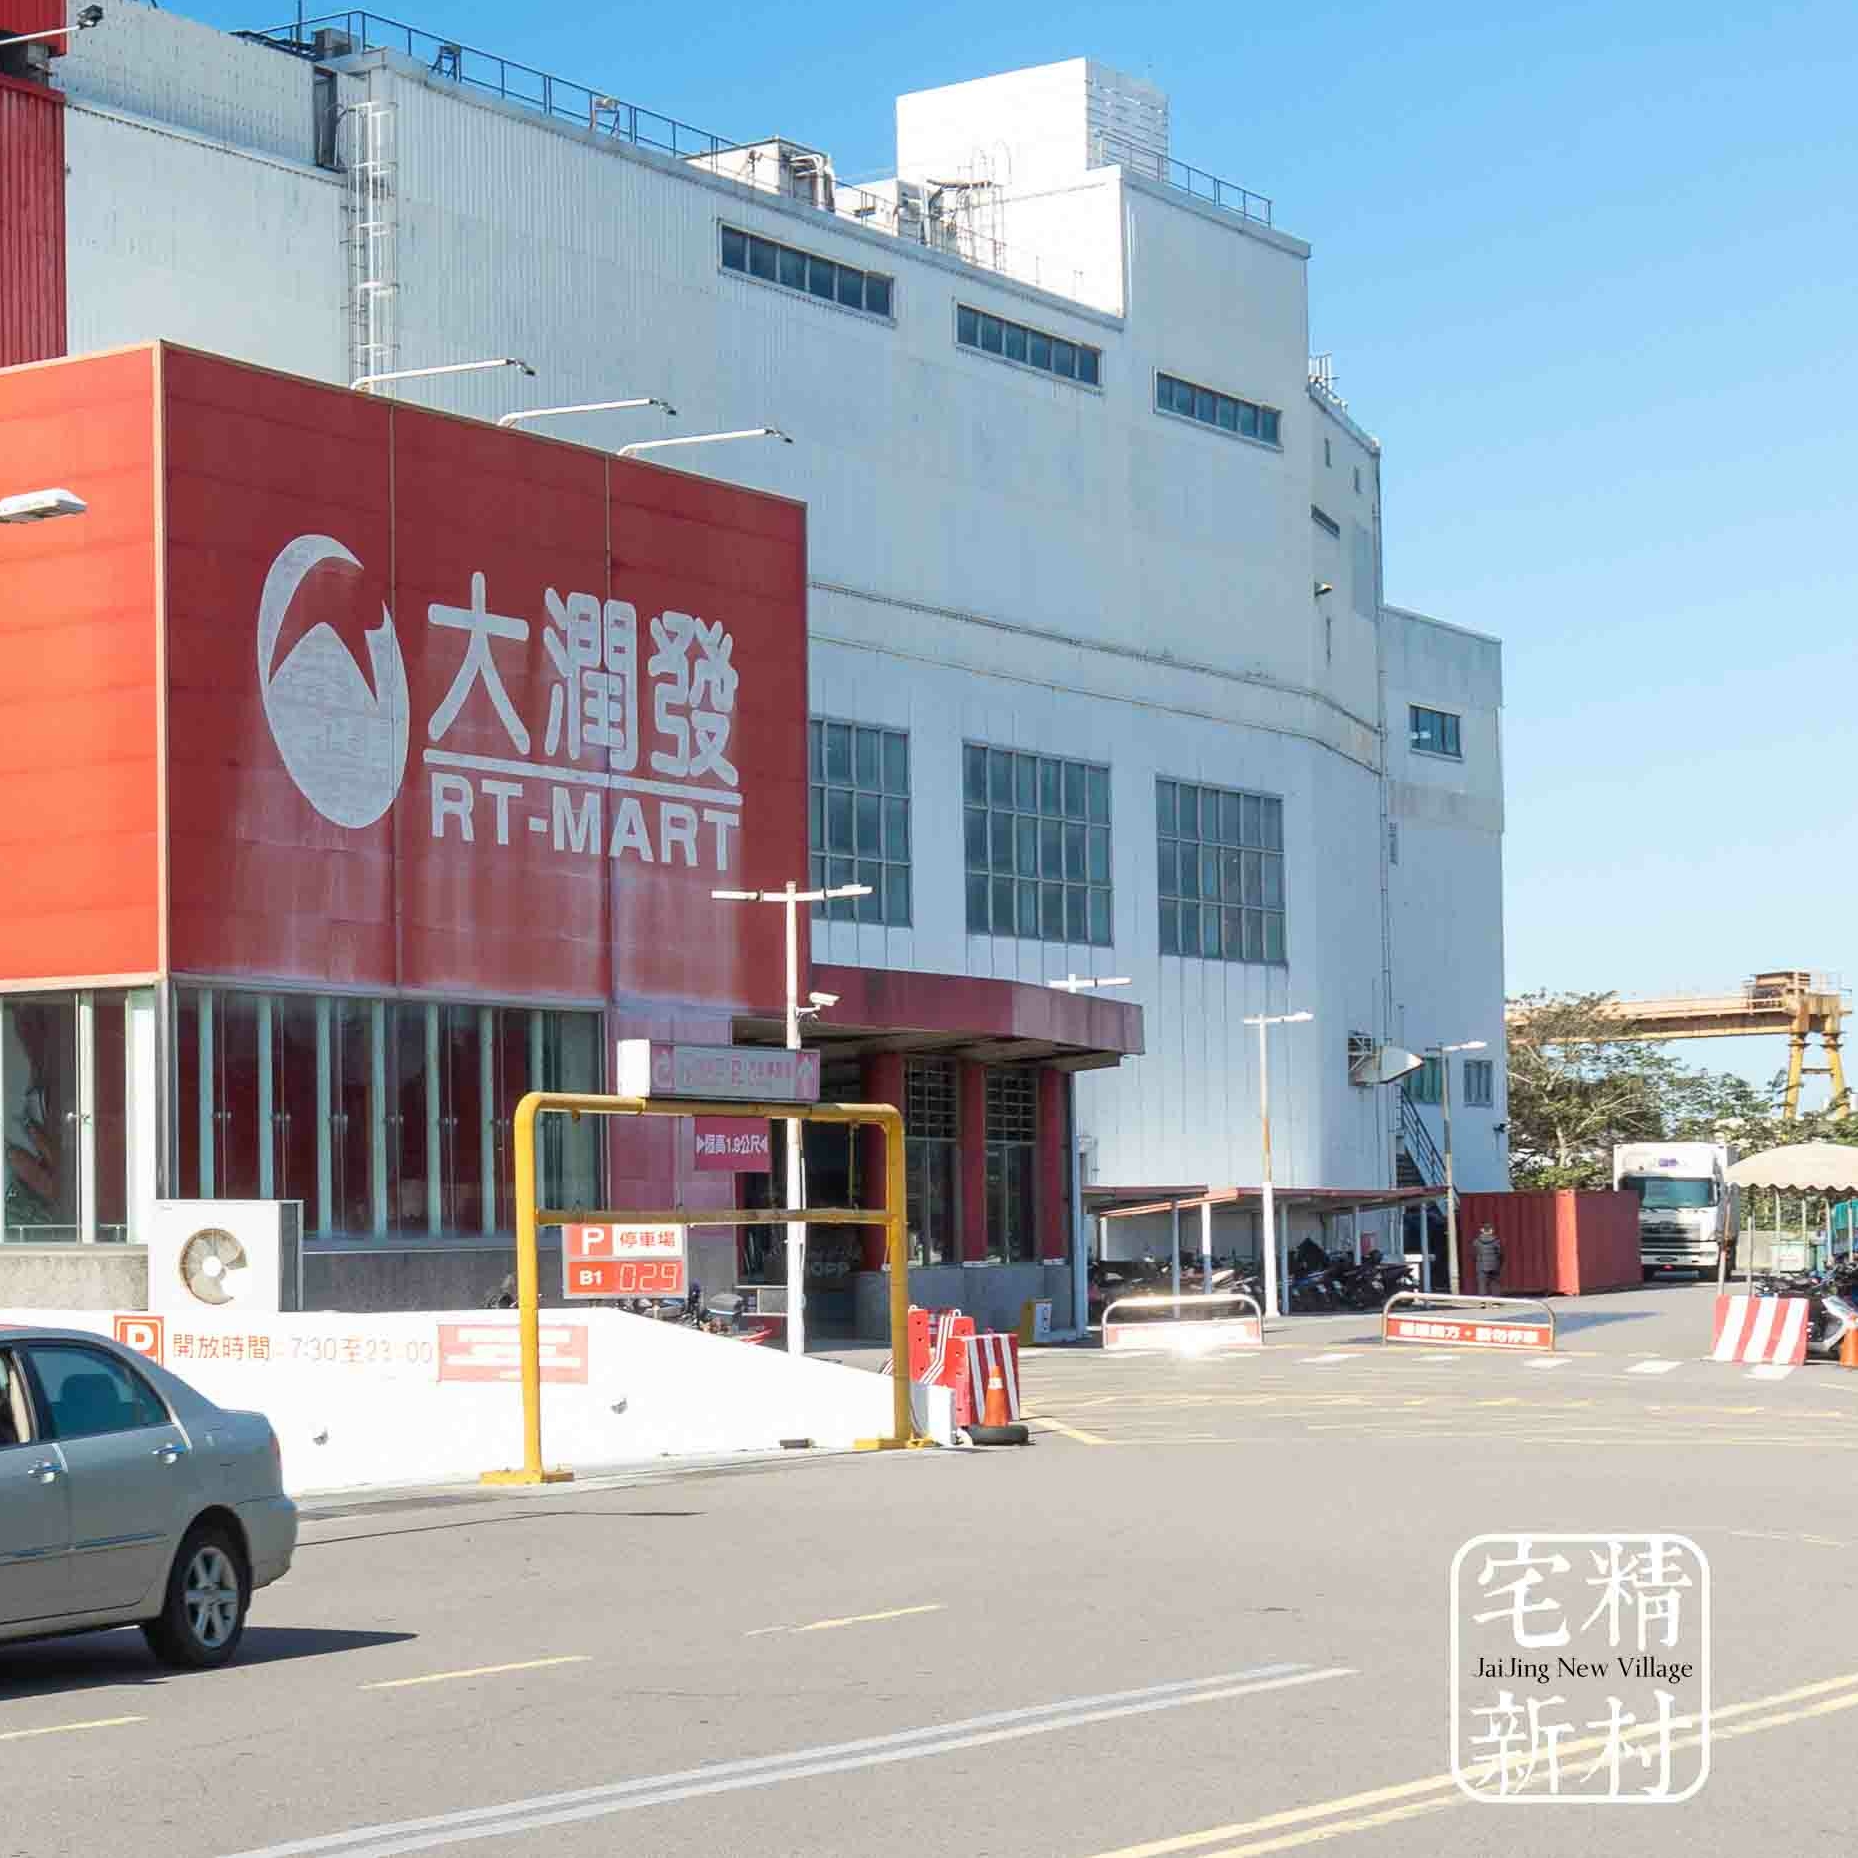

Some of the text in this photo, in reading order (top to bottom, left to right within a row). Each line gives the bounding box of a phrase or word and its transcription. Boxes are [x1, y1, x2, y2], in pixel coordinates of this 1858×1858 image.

[428, 571, 739, 787] 大潤發
[430, 774, 741, 871] RT-MART
[581, 1227, 675, 1255] P 停車場
[579, 1263, 677, 1291] B1 029
